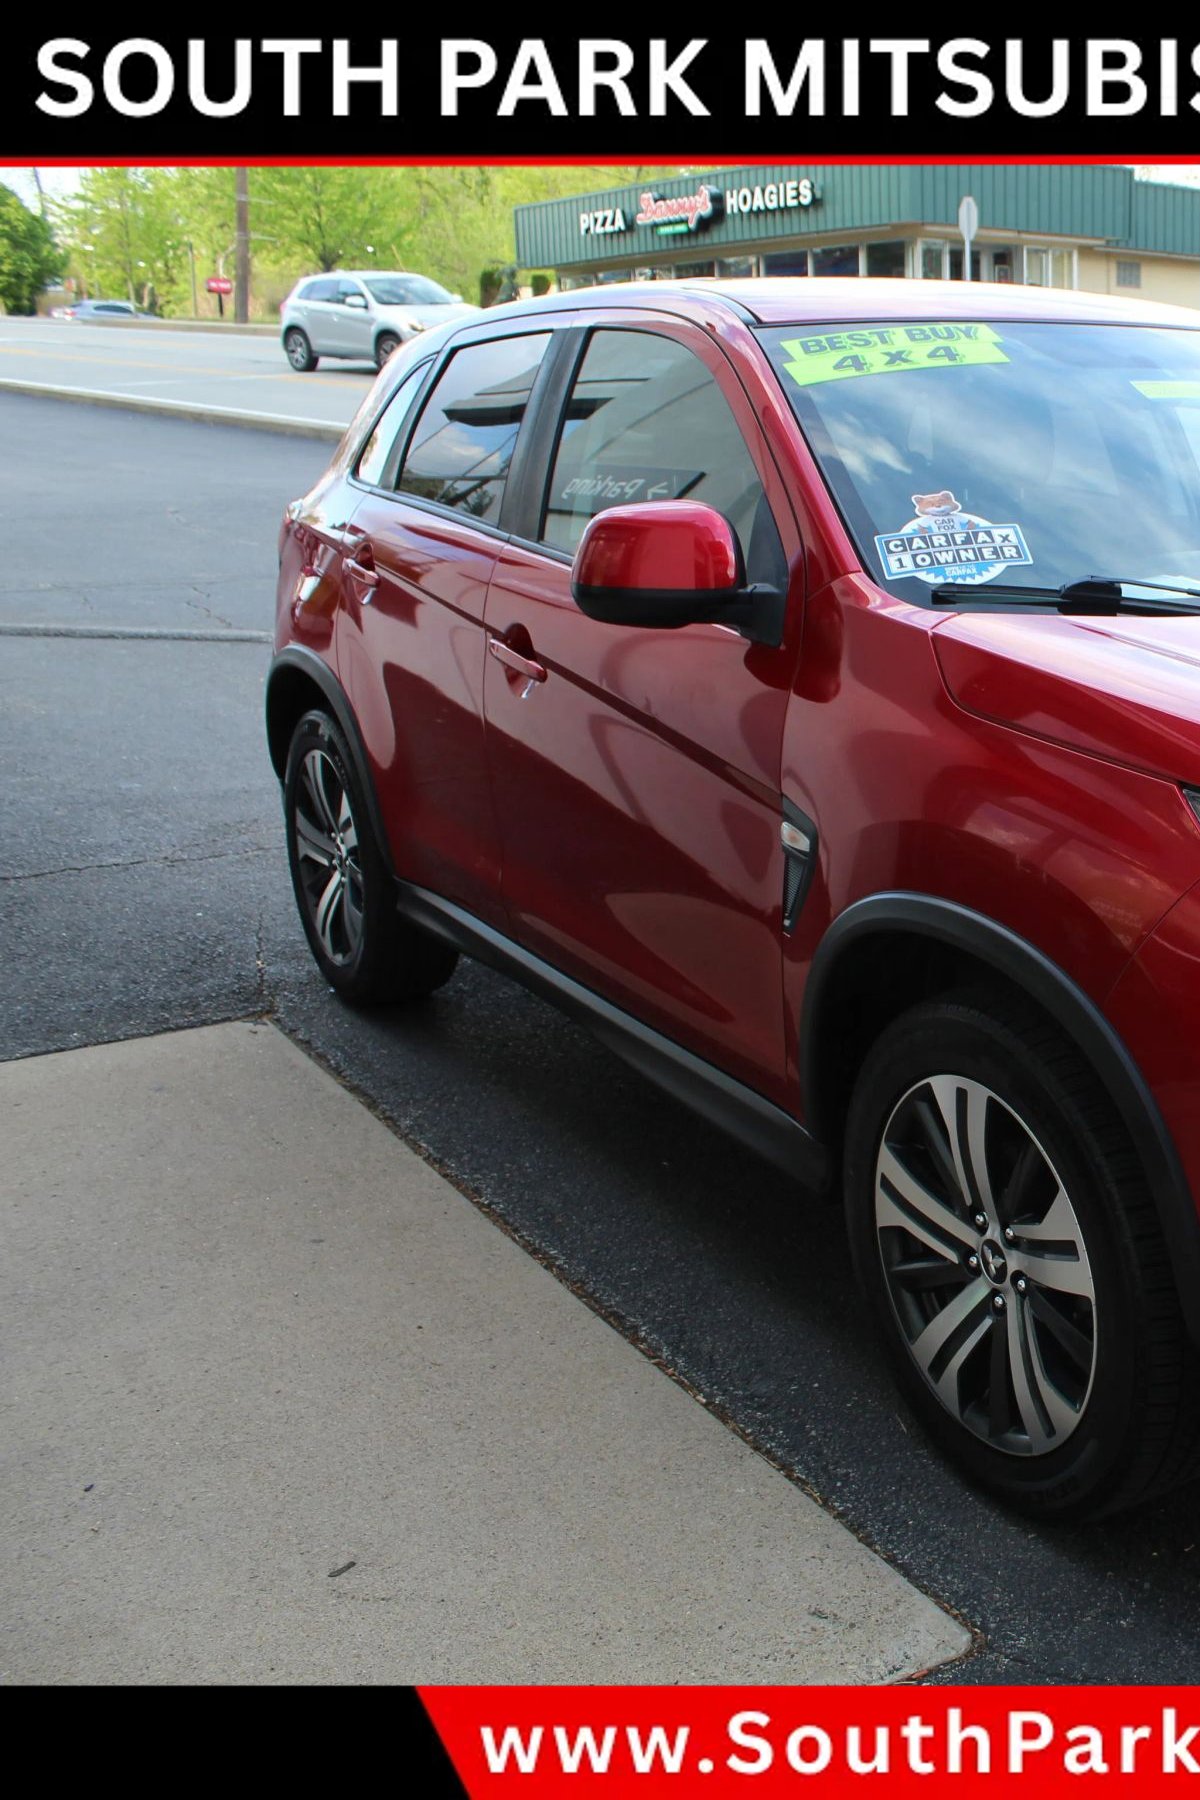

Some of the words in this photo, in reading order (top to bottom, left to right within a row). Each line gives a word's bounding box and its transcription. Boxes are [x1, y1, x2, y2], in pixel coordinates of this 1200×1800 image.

[579, 208, 626, 235] PIZZA
[726, 179, 813, 214] HOAGIES
[798, 329, 895, 356] BEST
[904, 324, 984, 344] BUY
[887, 531, 1013, 553] CARFAX
[915, 545, 1019, 567] OWNER
